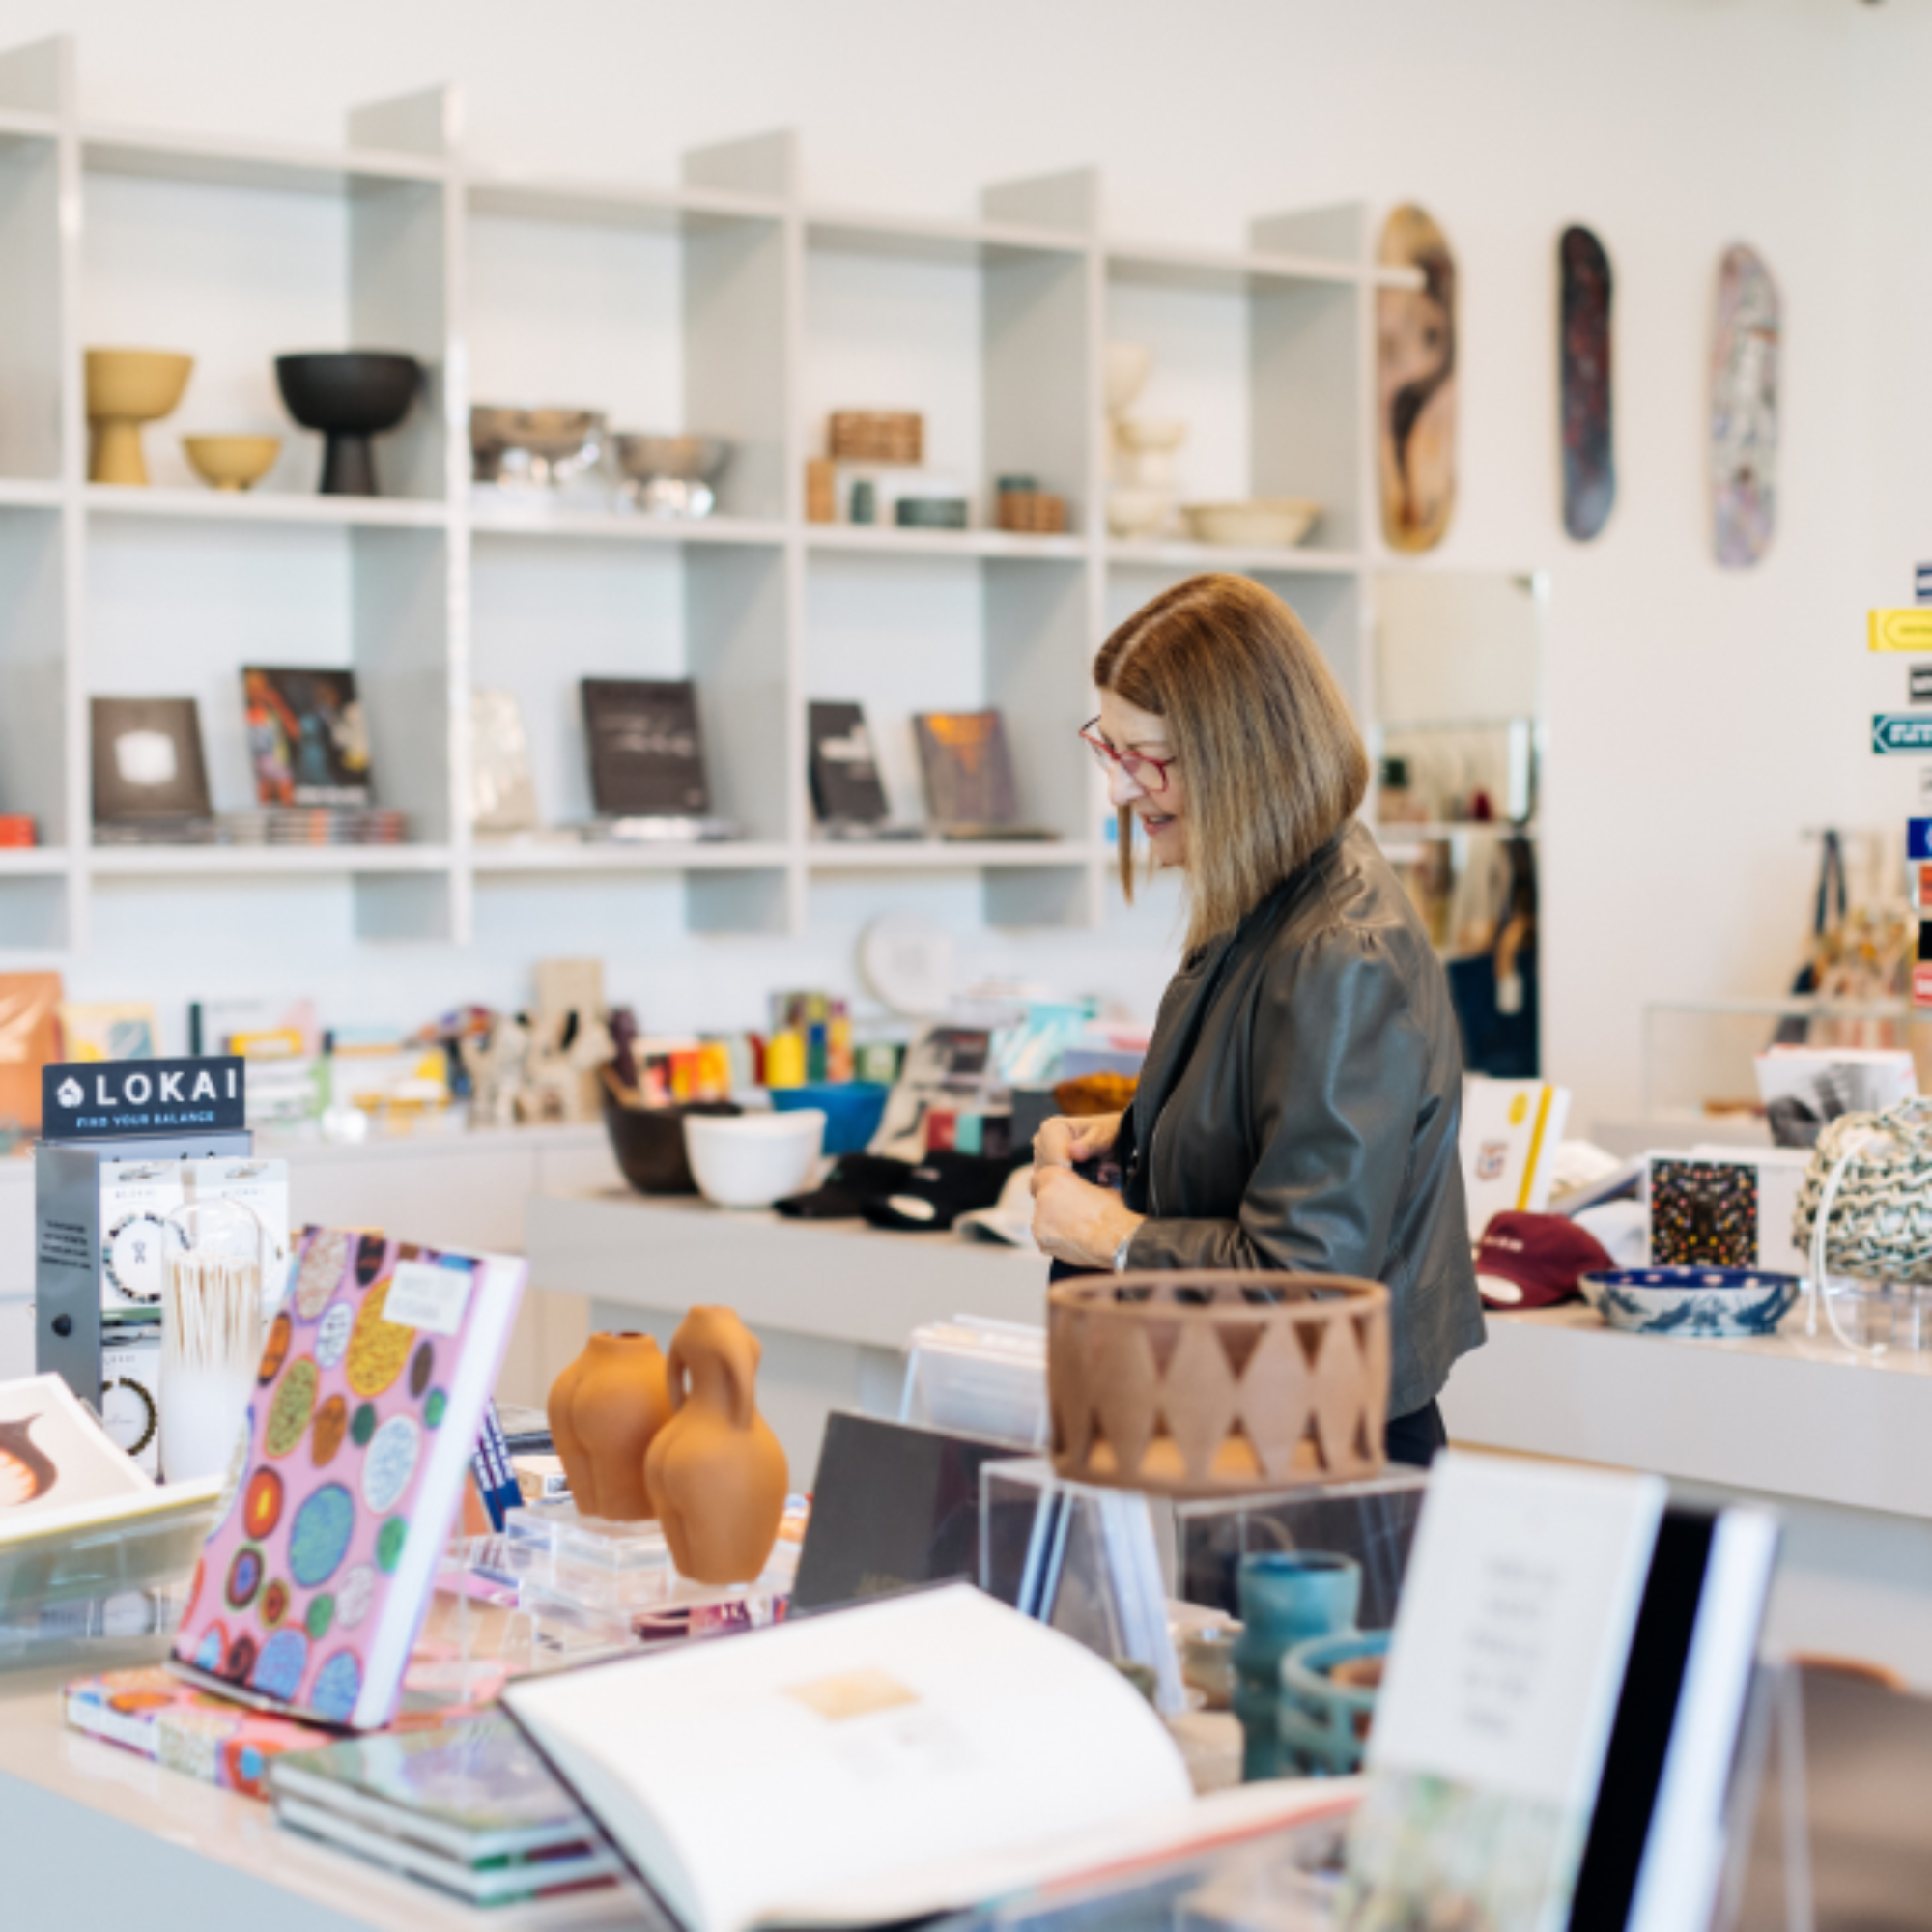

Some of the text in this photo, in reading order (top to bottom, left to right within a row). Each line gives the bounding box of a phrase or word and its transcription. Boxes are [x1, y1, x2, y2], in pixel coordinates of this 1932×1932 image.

[96, 1068, 237, 1106] LOKAI
[113, 1113, 150, 1128] YOUR
[154, 1110, 215, 1125] BALANCE
